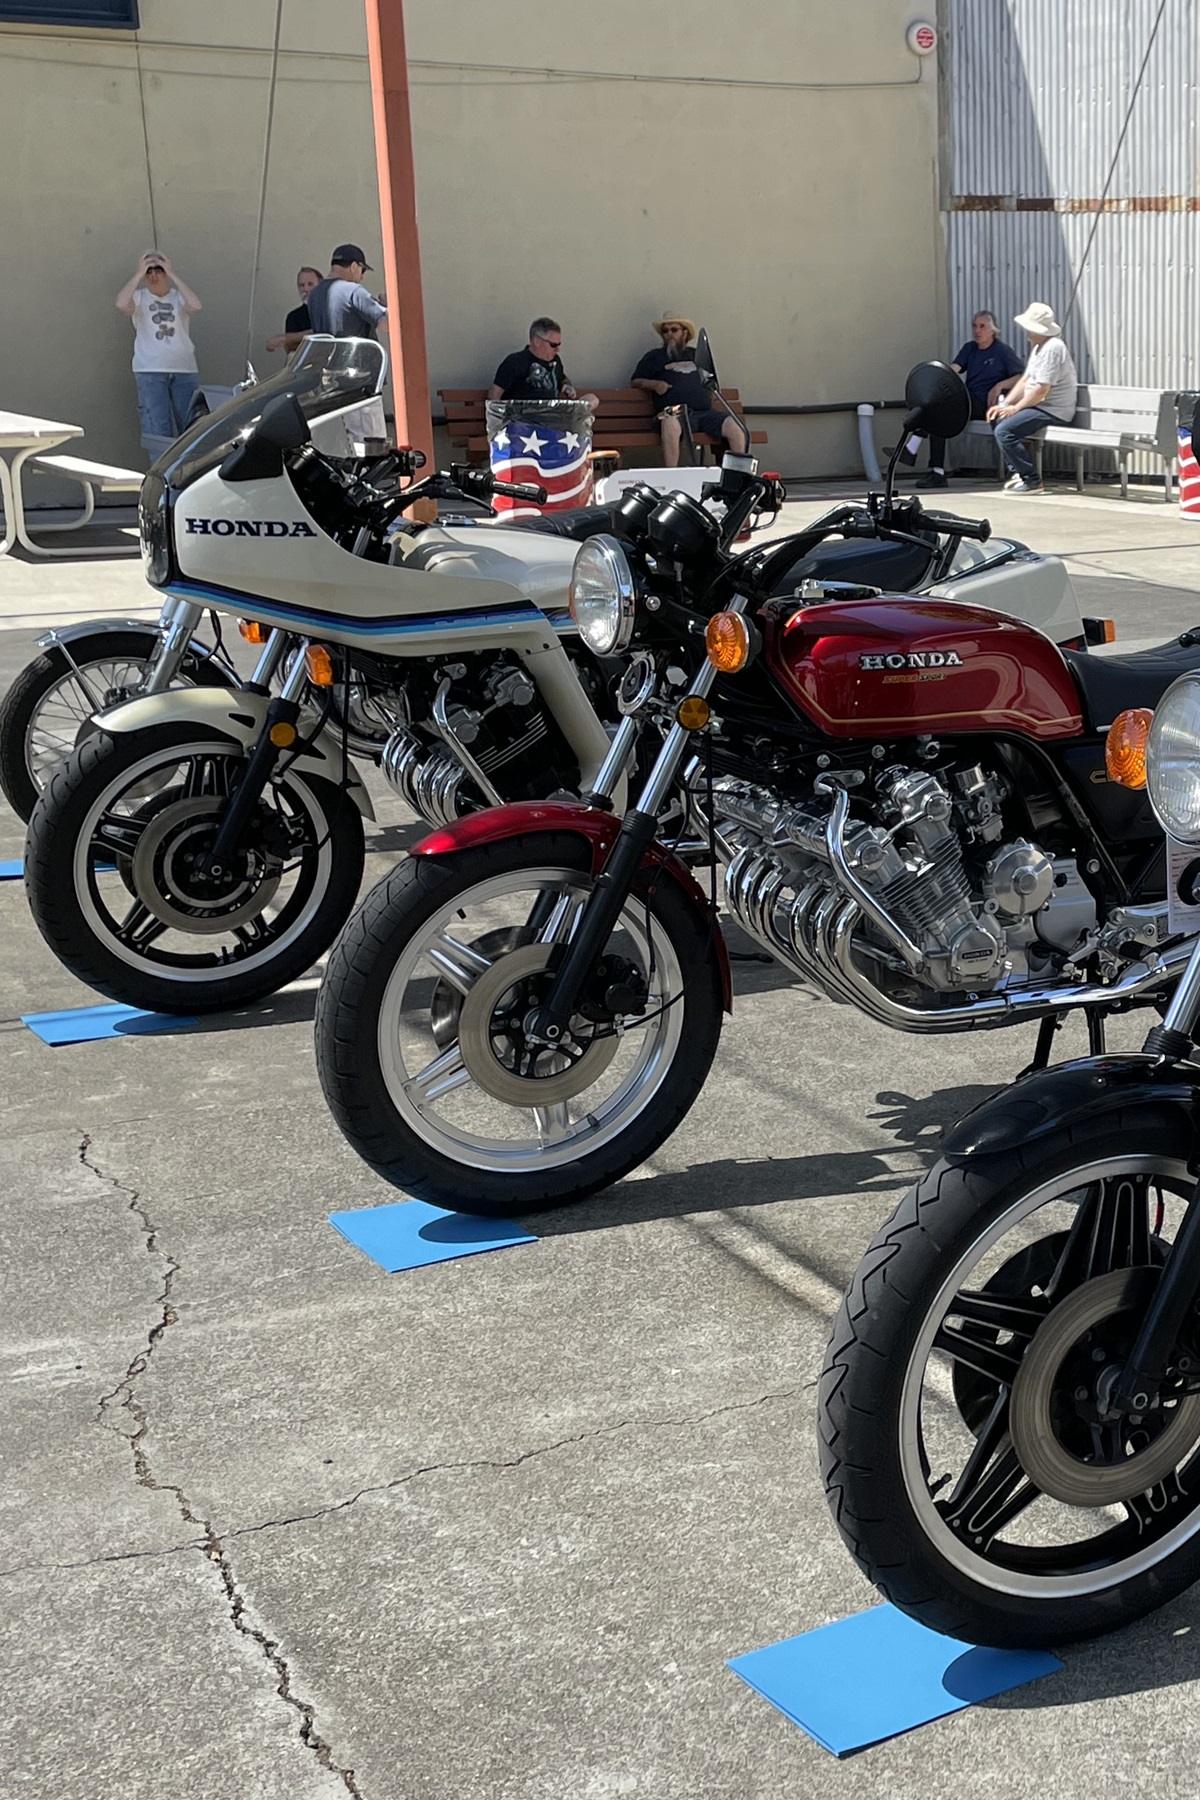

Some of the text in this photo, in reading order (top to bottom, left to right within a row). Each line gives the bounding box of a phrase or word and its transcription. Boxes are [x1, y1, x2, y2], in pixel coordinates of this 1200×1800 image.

[185, 518, 318, 537] HONDA
[860, 651, 964, 671] HONDA
[963, 949, 992, 959] HONDA
